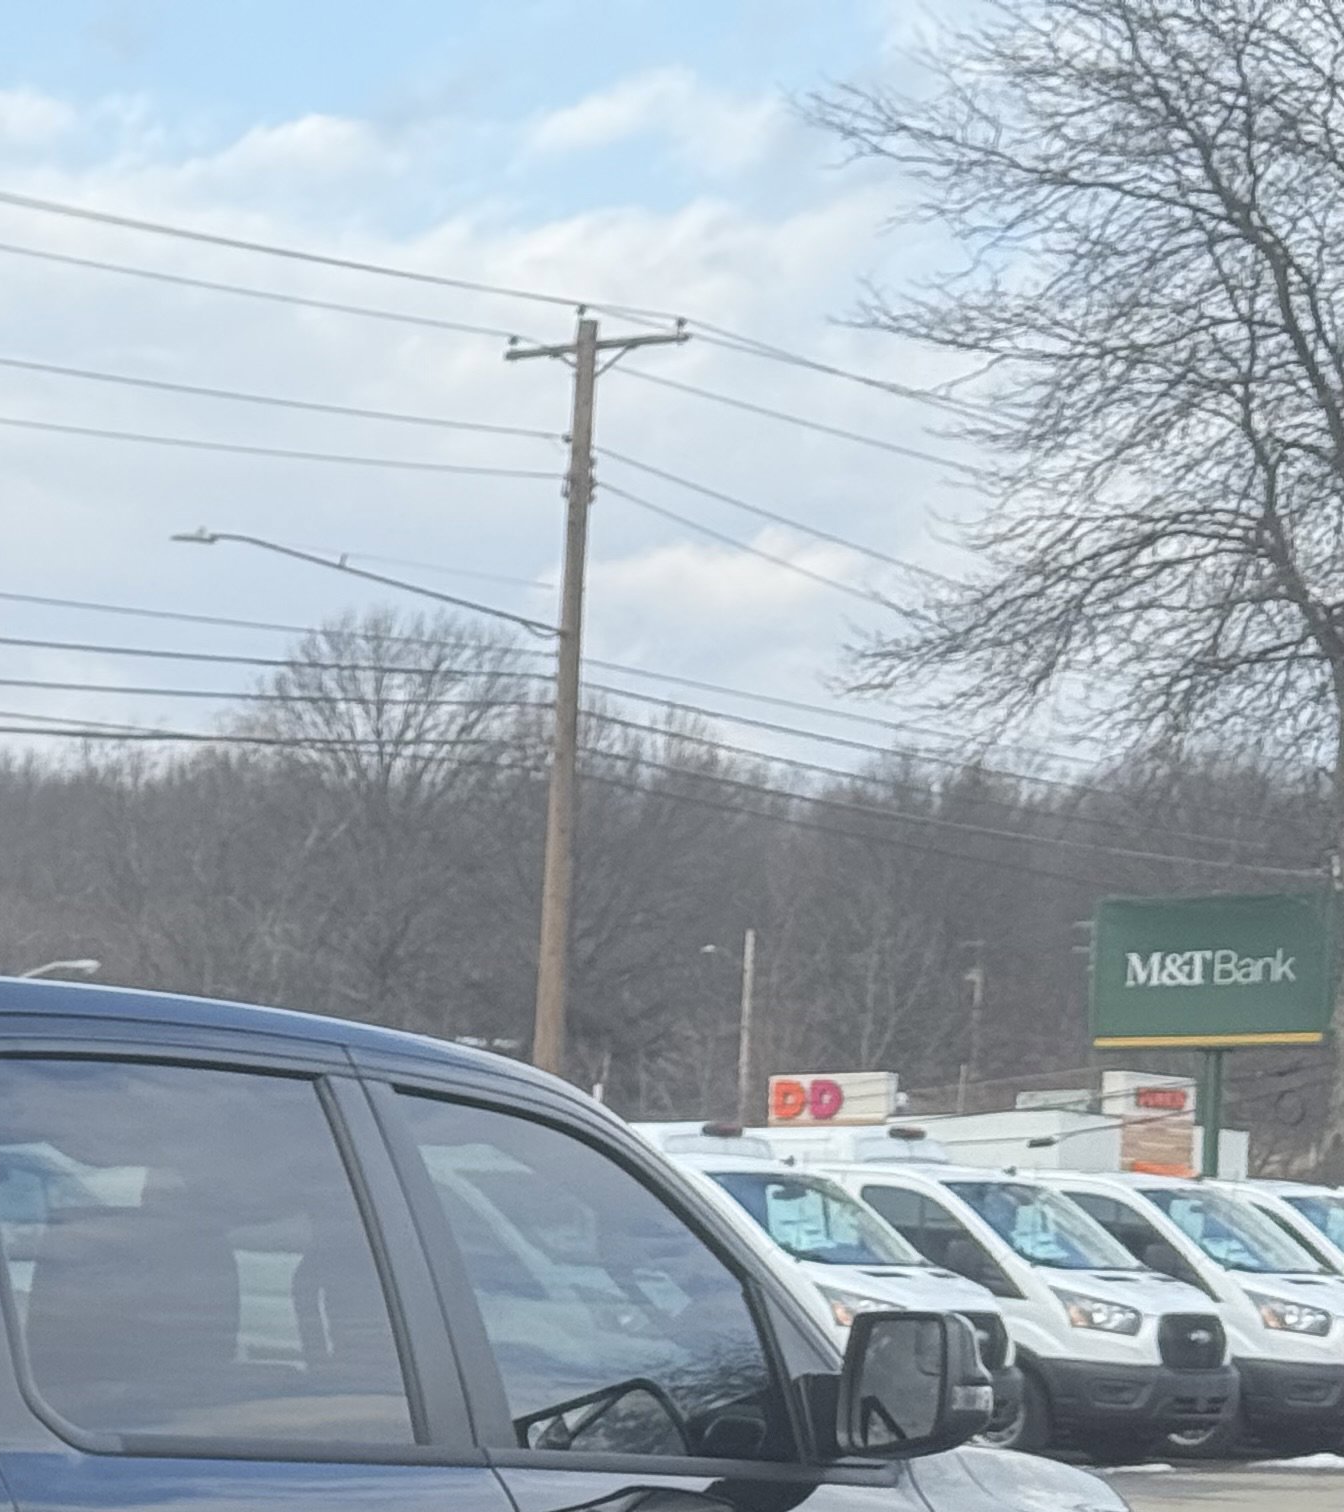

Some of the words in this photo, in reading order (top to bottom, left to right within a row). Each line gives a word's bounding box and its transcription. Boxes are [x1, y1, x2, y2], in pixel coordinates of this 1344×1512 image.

[1125, 950, 1213, 987] M&T
[1213, 948, 1297, 985] Bank
[774, 1079, 843, 1120] DD
